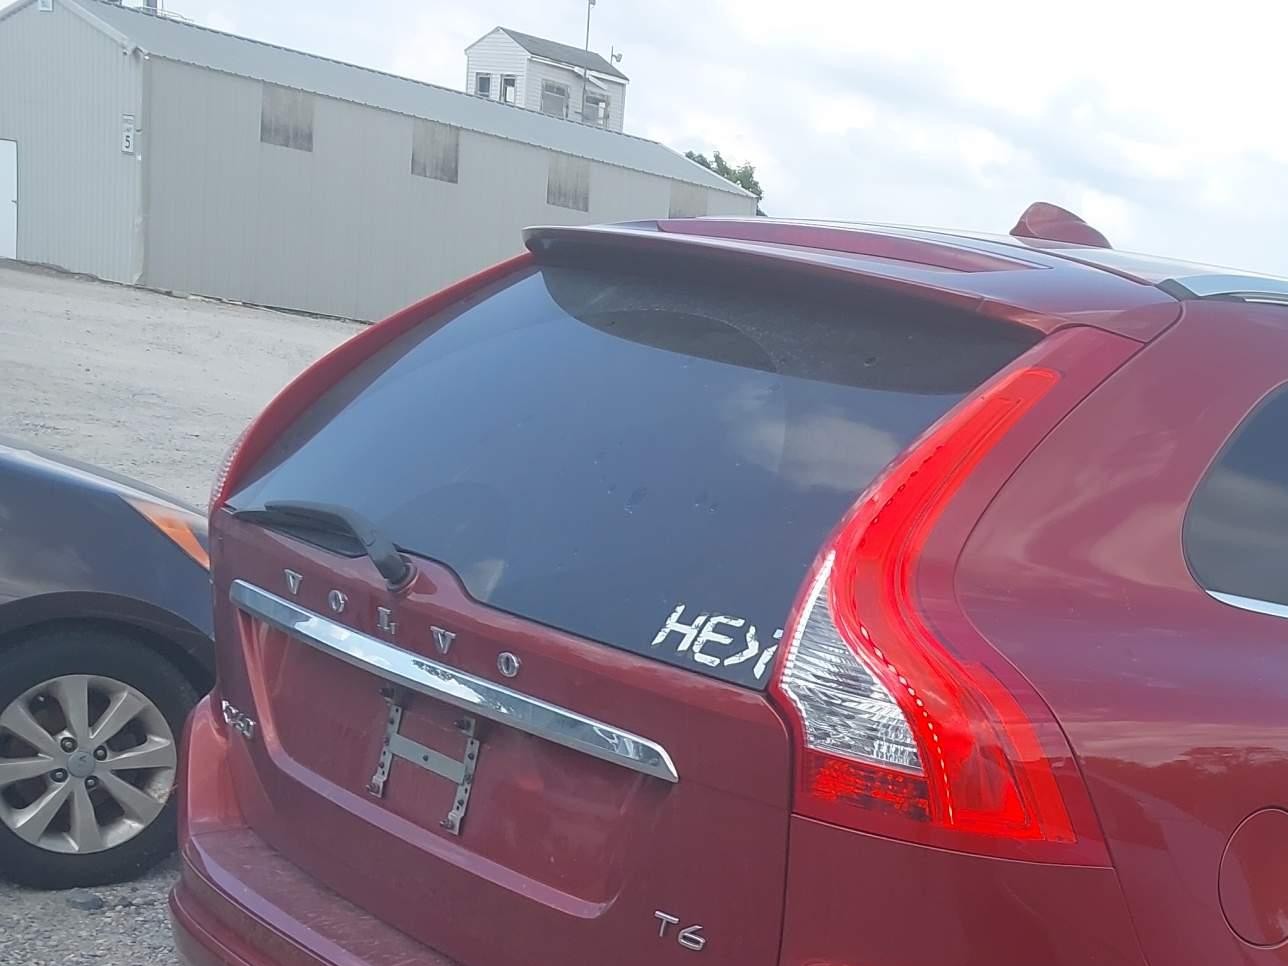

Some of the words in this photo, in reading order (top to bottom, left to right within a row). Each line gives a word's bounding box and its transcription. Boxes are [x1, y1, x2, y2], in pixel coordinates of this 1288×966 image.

[124, 135, 131, 149] 5
[284, 569, 521, 678] VOLVO
[654, 909, 706, 951] T6
